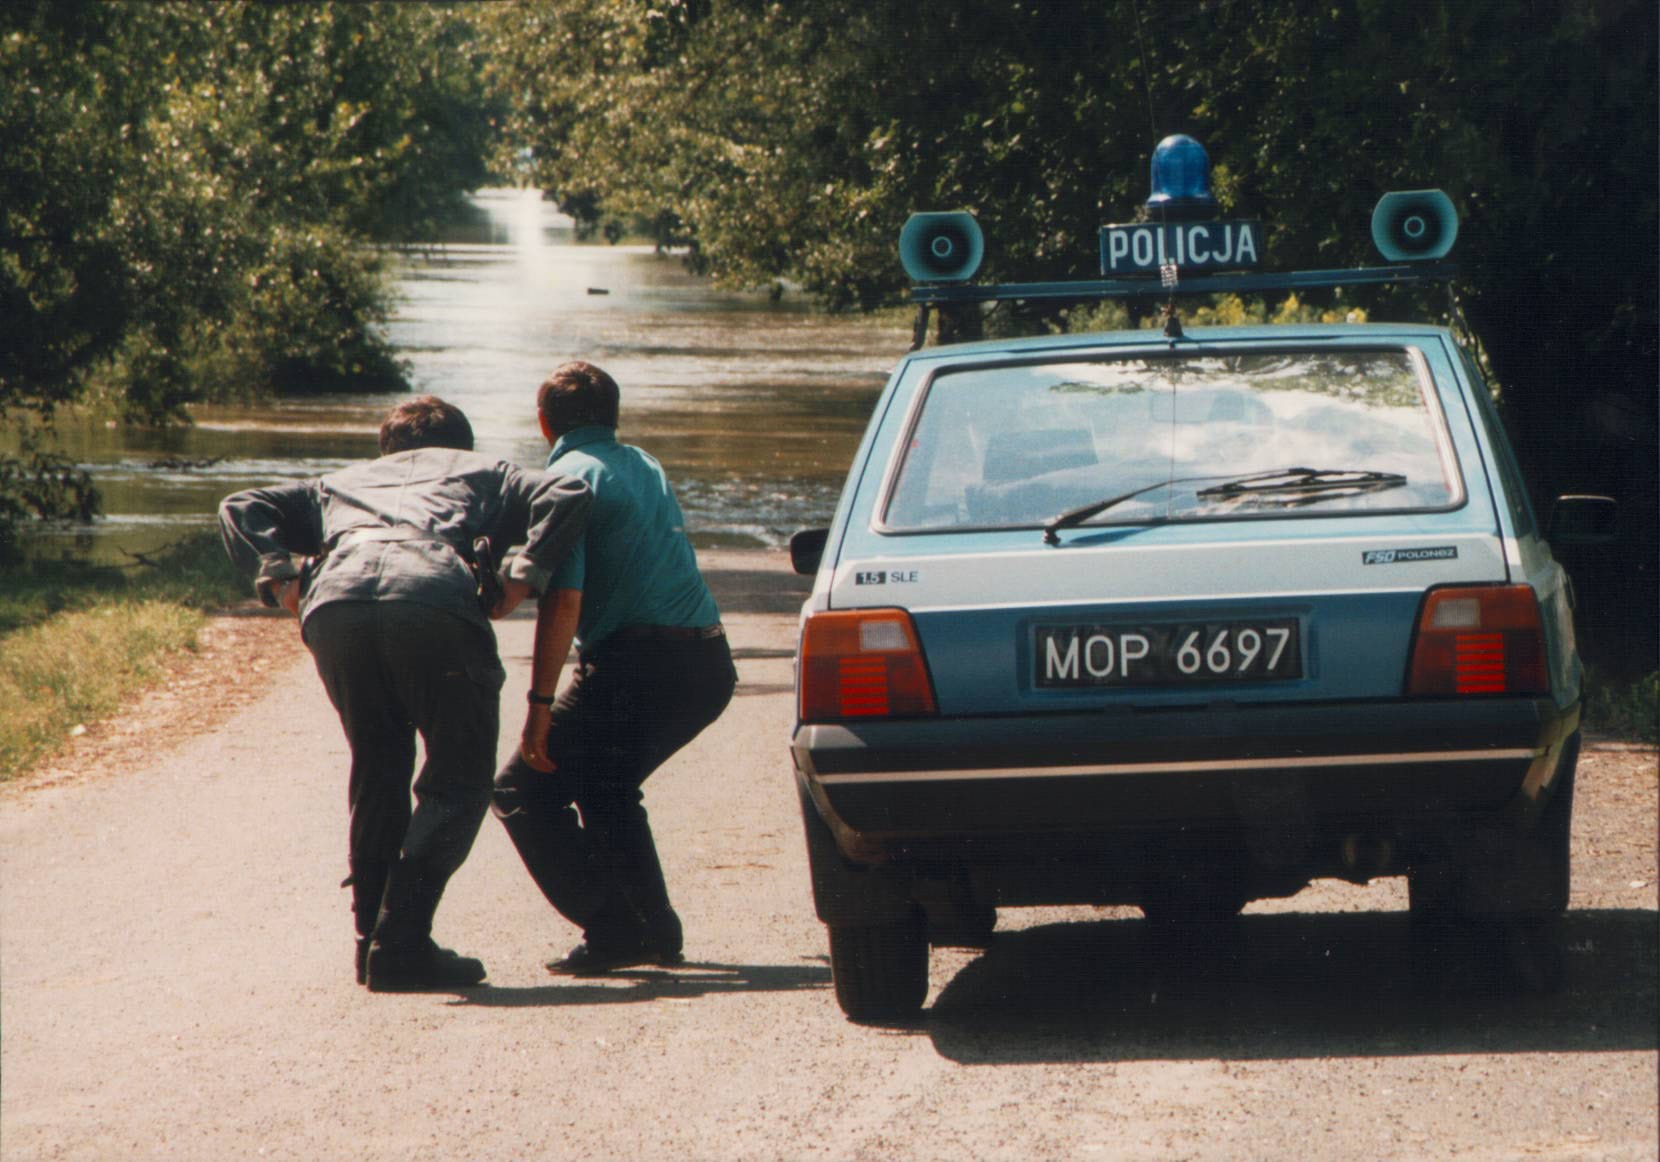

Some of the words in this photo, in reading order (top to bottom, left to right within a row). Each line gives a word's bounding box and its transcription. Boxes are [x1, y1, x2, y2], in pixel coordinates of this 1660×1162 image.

[1109, 224, 1257, 269] POLICJA
[1365, 551, 1396, 564] FSO
[890, 571, 919, 583] SLE
[1046, 634, 1150, 679] MOP
[1177, 628, 1290, 674] 6697
